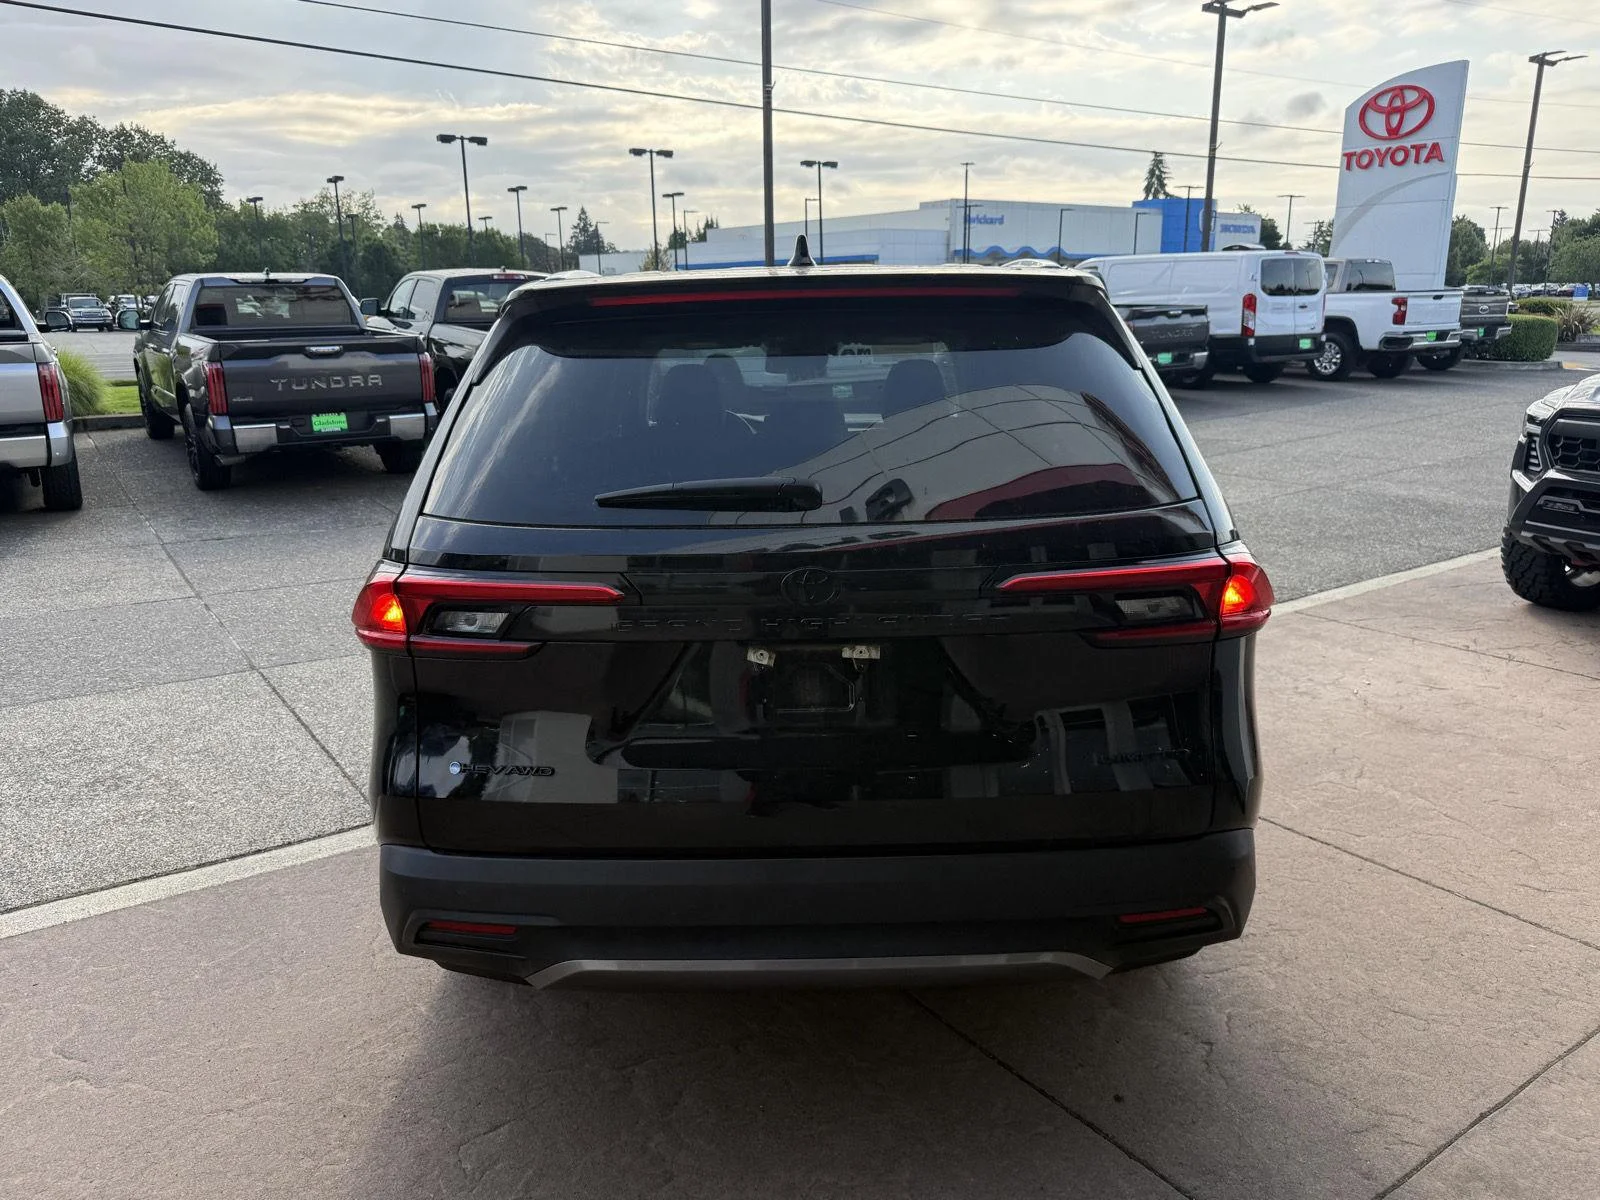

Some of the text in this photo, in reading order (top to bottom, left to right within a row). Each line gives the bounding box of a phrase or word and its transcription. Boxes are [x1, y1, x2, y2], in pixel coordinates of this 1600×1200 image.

[1342, 142, 1445, 171] TOYOTA
[1220, 224, 1256, 234] HONDA
[270, 374, 383, 391] TUNDRA
